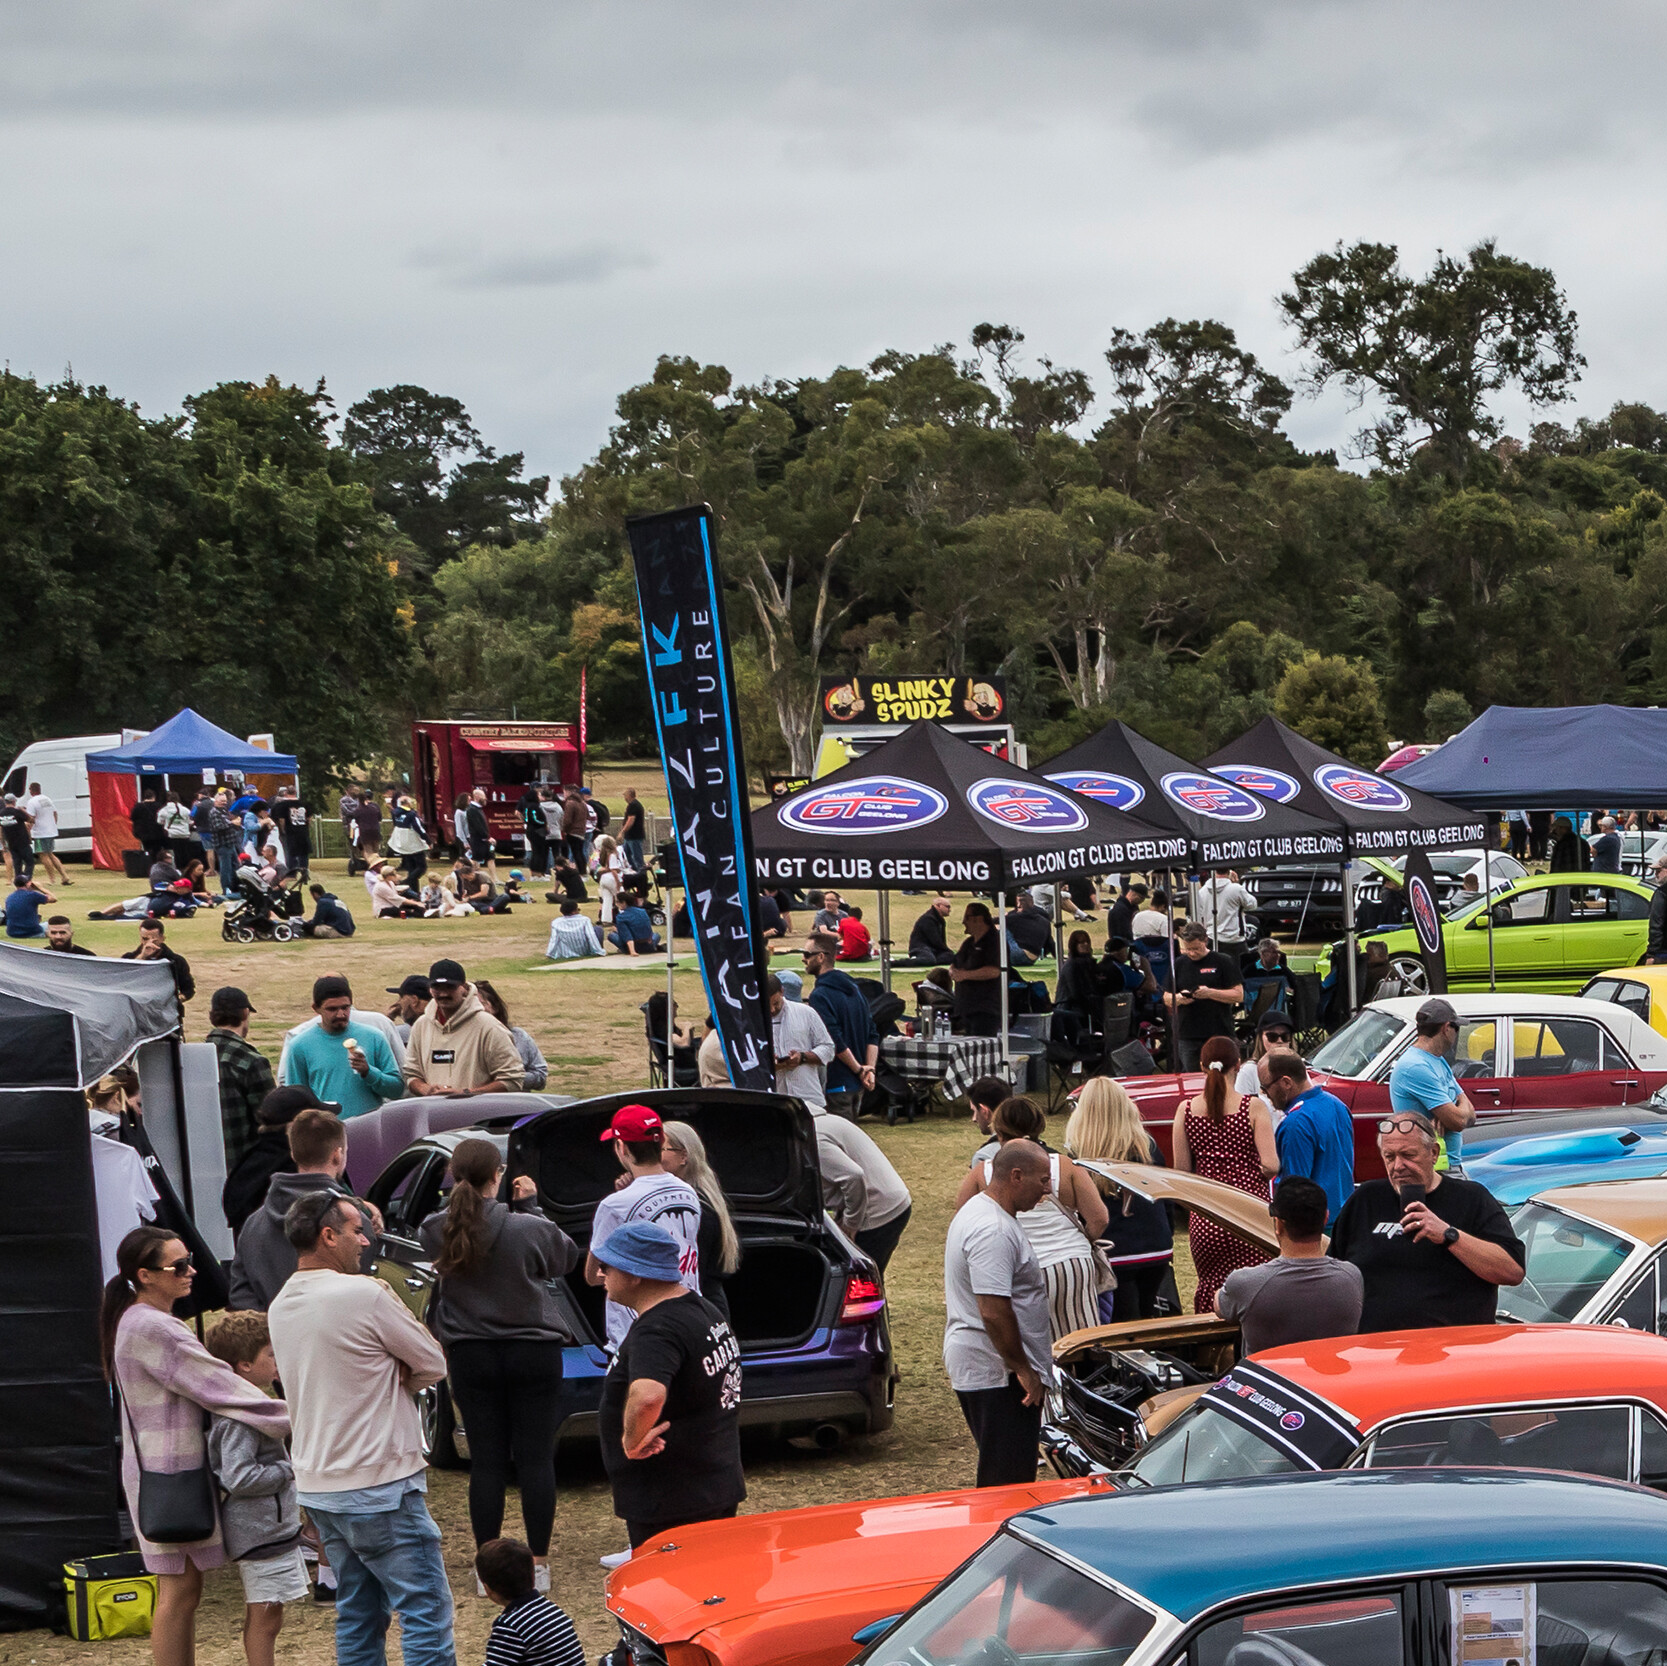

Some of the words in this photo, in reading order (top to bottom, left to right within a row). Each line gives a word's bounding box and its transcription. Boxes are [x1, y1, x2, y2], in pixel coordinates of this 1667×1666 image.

[871, 678, 956, 703] SLINKY
[691, 608, 728, 820] CULTURE
[877, 700, 954, 723] SPUDZ
[823, 791, 865, 800] FALCON
[1179, 789, 1236, 811] GT
[1331, 779, 1382, 801] GT
[800, 796, 922, 820] GT
[986, 797, 1054, 824] GT
[1355, 830, 1393, 849] FALCON
[1394, 830, 1408, 846] GT
[1409, 828, 1437, 846] CLUB
[1437, 824, 1485, 844] GEELONG
[1012, 852, 1066, 878] FALCON
[1068, 847, 1086, 868] GT
[1088, 843, 1124, 865] CLUB
[1127, 838, 1187, 861] GEELONG
[1203, 841, 1246, 862] FALCON
[1247, 841, 1263, 857] GT
[1264, 838, 1292, 856] CLUB
[1293, 836, 1344, 855] GEELONG
[776, 857, 806, 878] GT
[811, 858, 873, 879] CLUB
[878, 859, 990, 881] GEELONG
